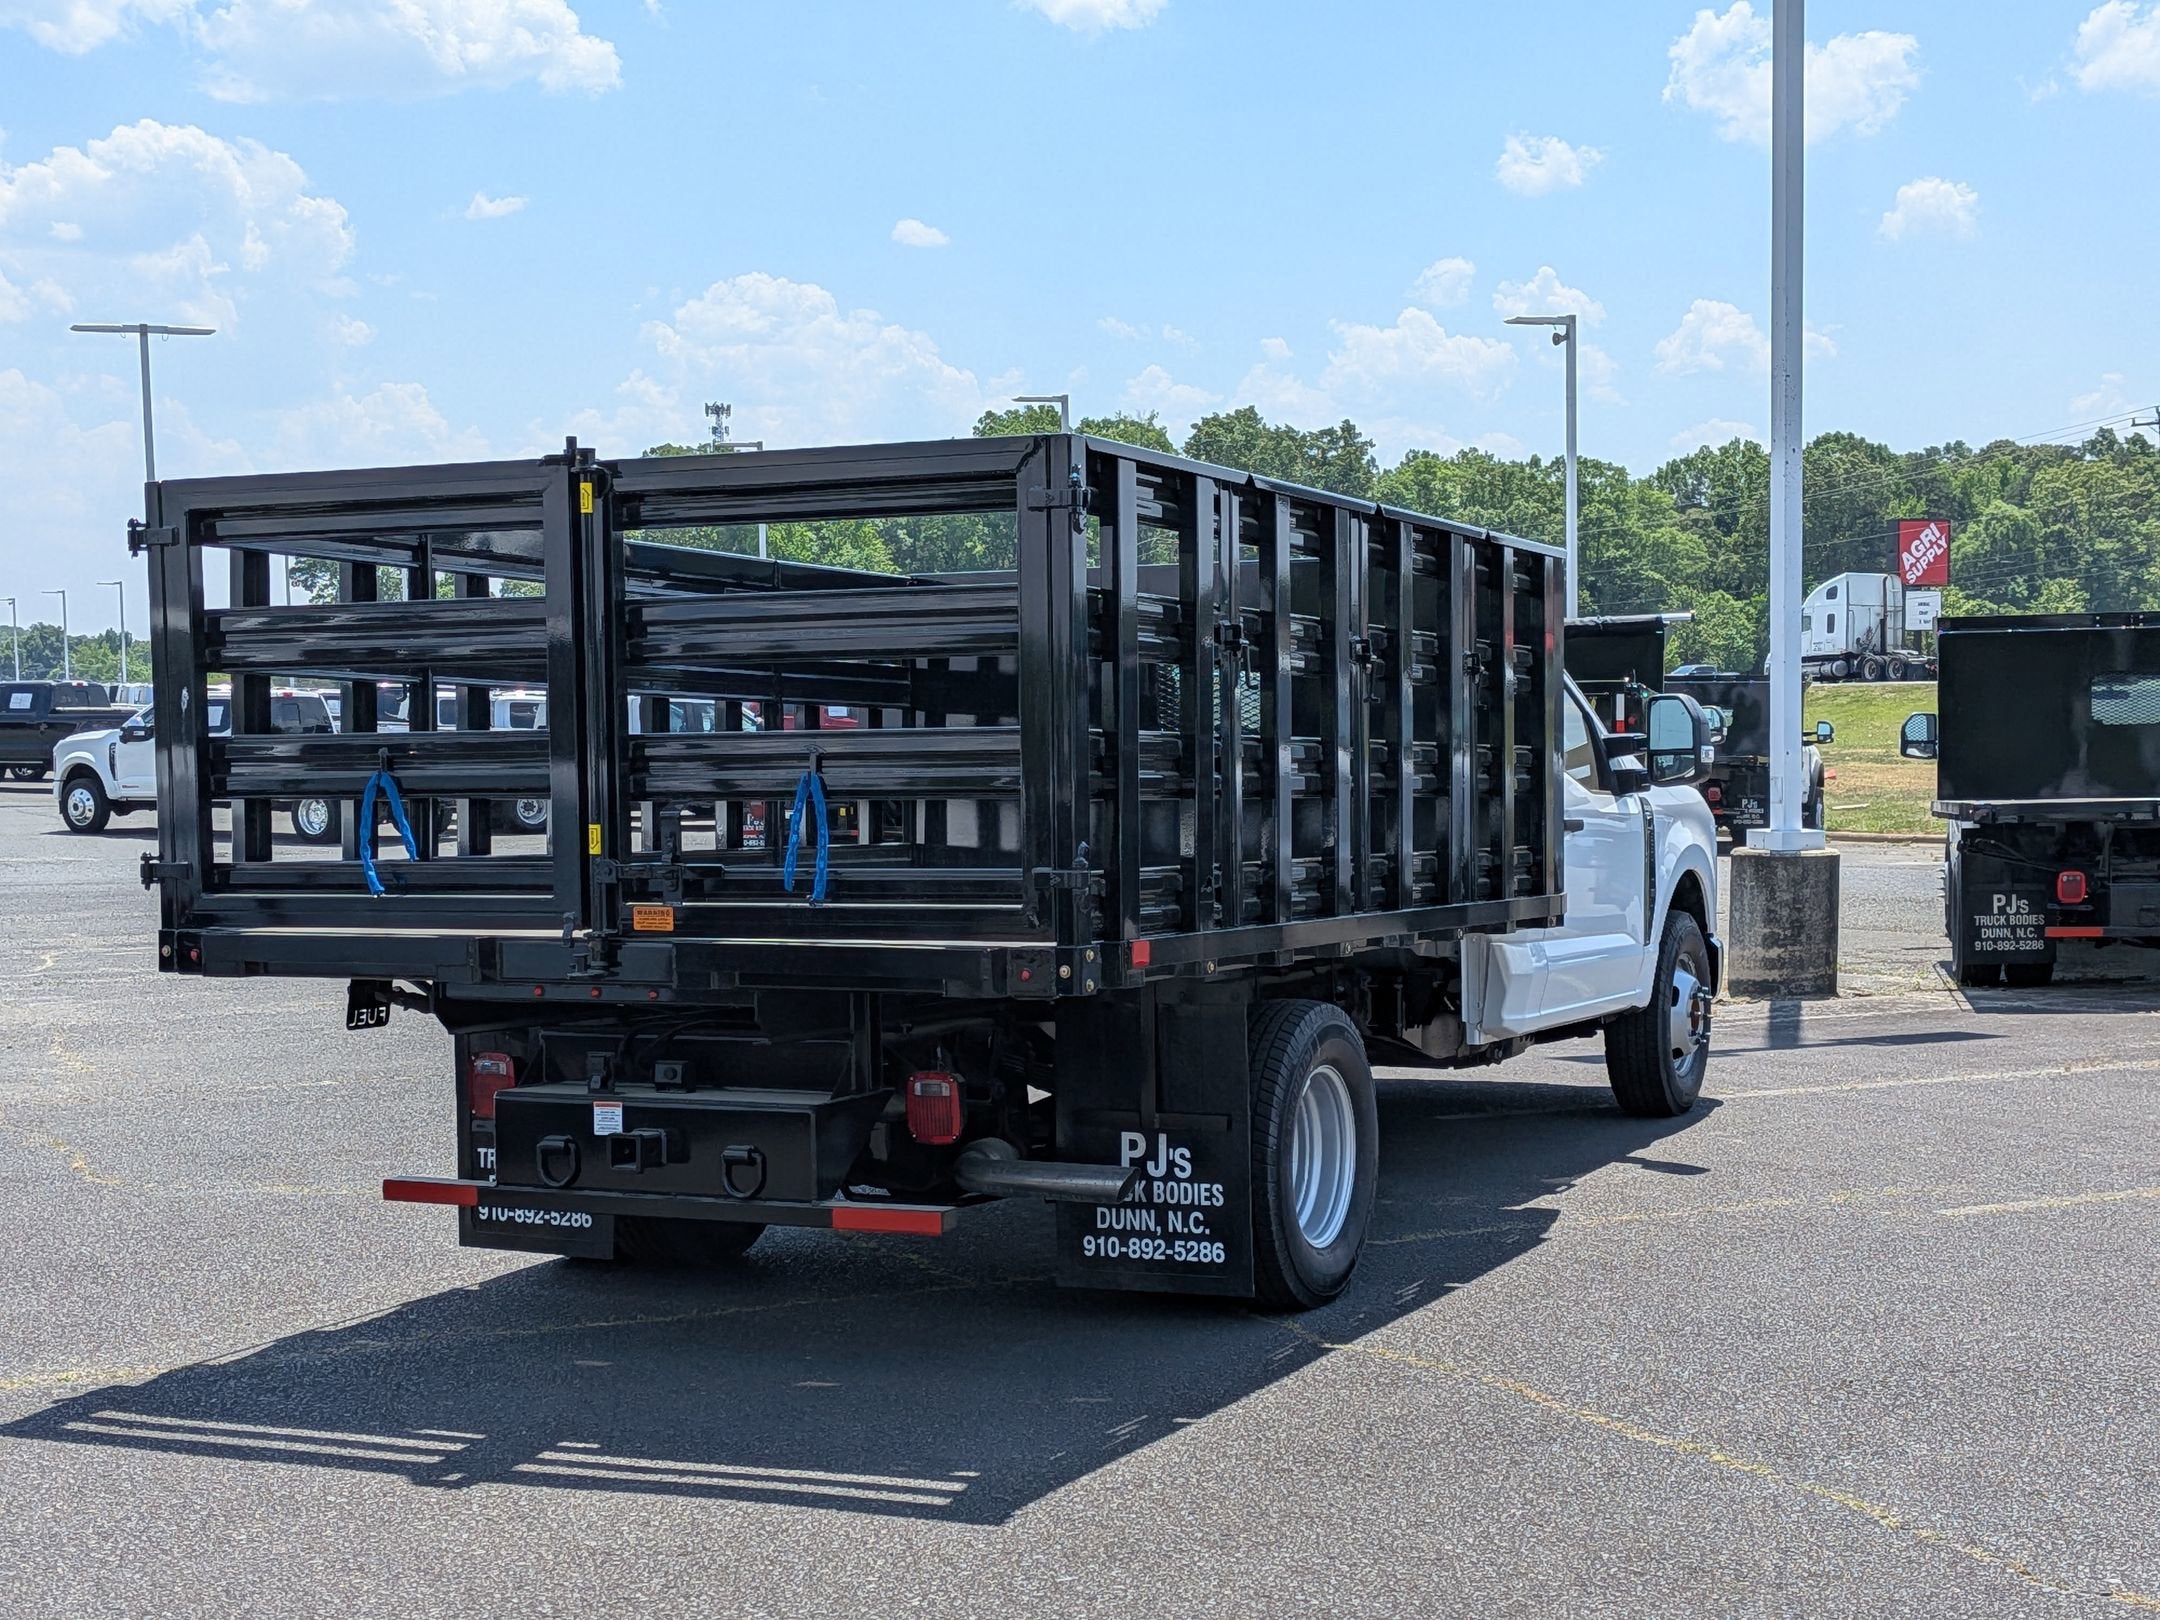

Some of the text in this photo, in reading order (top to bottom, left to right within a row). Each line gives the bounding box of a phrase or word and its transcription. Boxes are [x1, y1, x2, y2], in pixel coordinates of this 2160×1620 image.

[1902, 522, 1940, 570] AGRI
[1906, 533, 1948, 584] SUPPLY
[1974, 914, 2045, 926] TRUCK BODIES
[1981, 927, 2038, 939] DUNN, N.C.
[1974, 940, 2045, 951] 910-892-5286
[1153, 1181, 1225, 1207] BODIES
[1096, 1207, 1211, 1236] DUNN, N.C.
[1083, 1235, 1226, 1263] 910-892-5286
